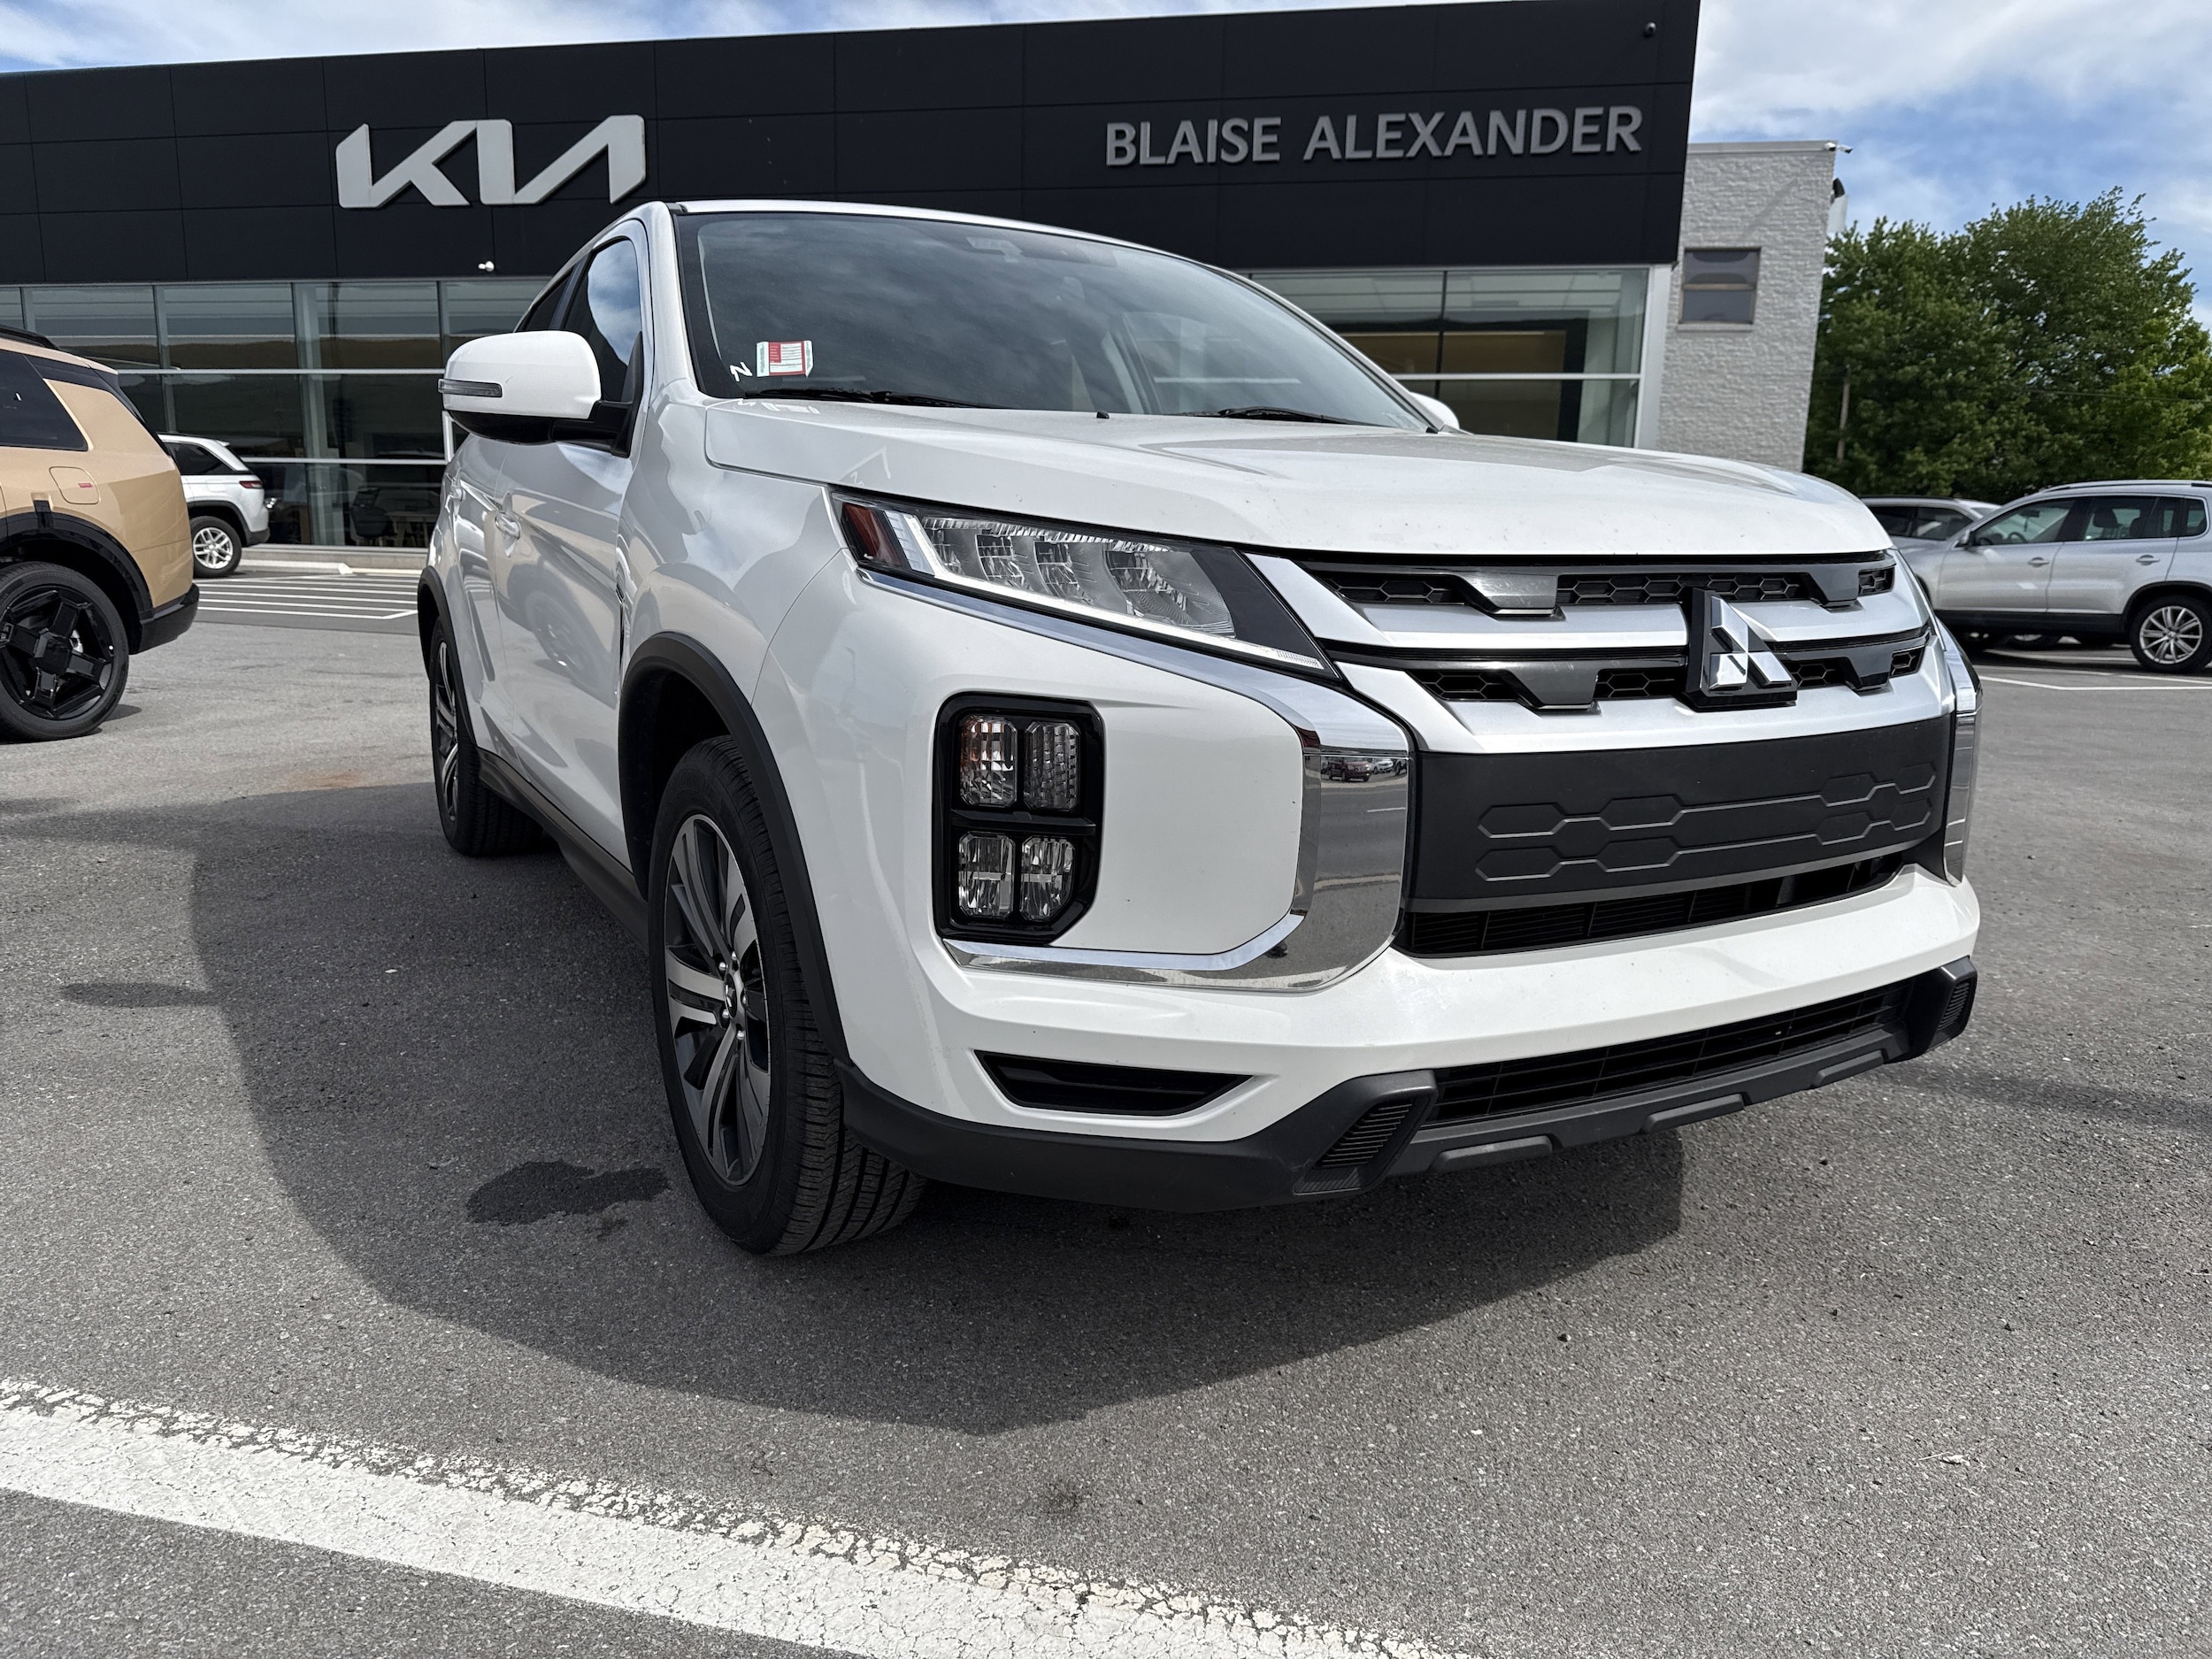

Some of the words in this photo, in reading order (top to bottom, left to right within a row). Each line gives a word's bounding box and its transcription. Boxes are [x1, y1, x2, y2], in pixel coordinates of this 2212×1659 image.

[335, 114, 647, 209] KIA
[1105, 116, 1282, 166] BLAISE
[1302, 104, 1643, 162] ALEXANDER
